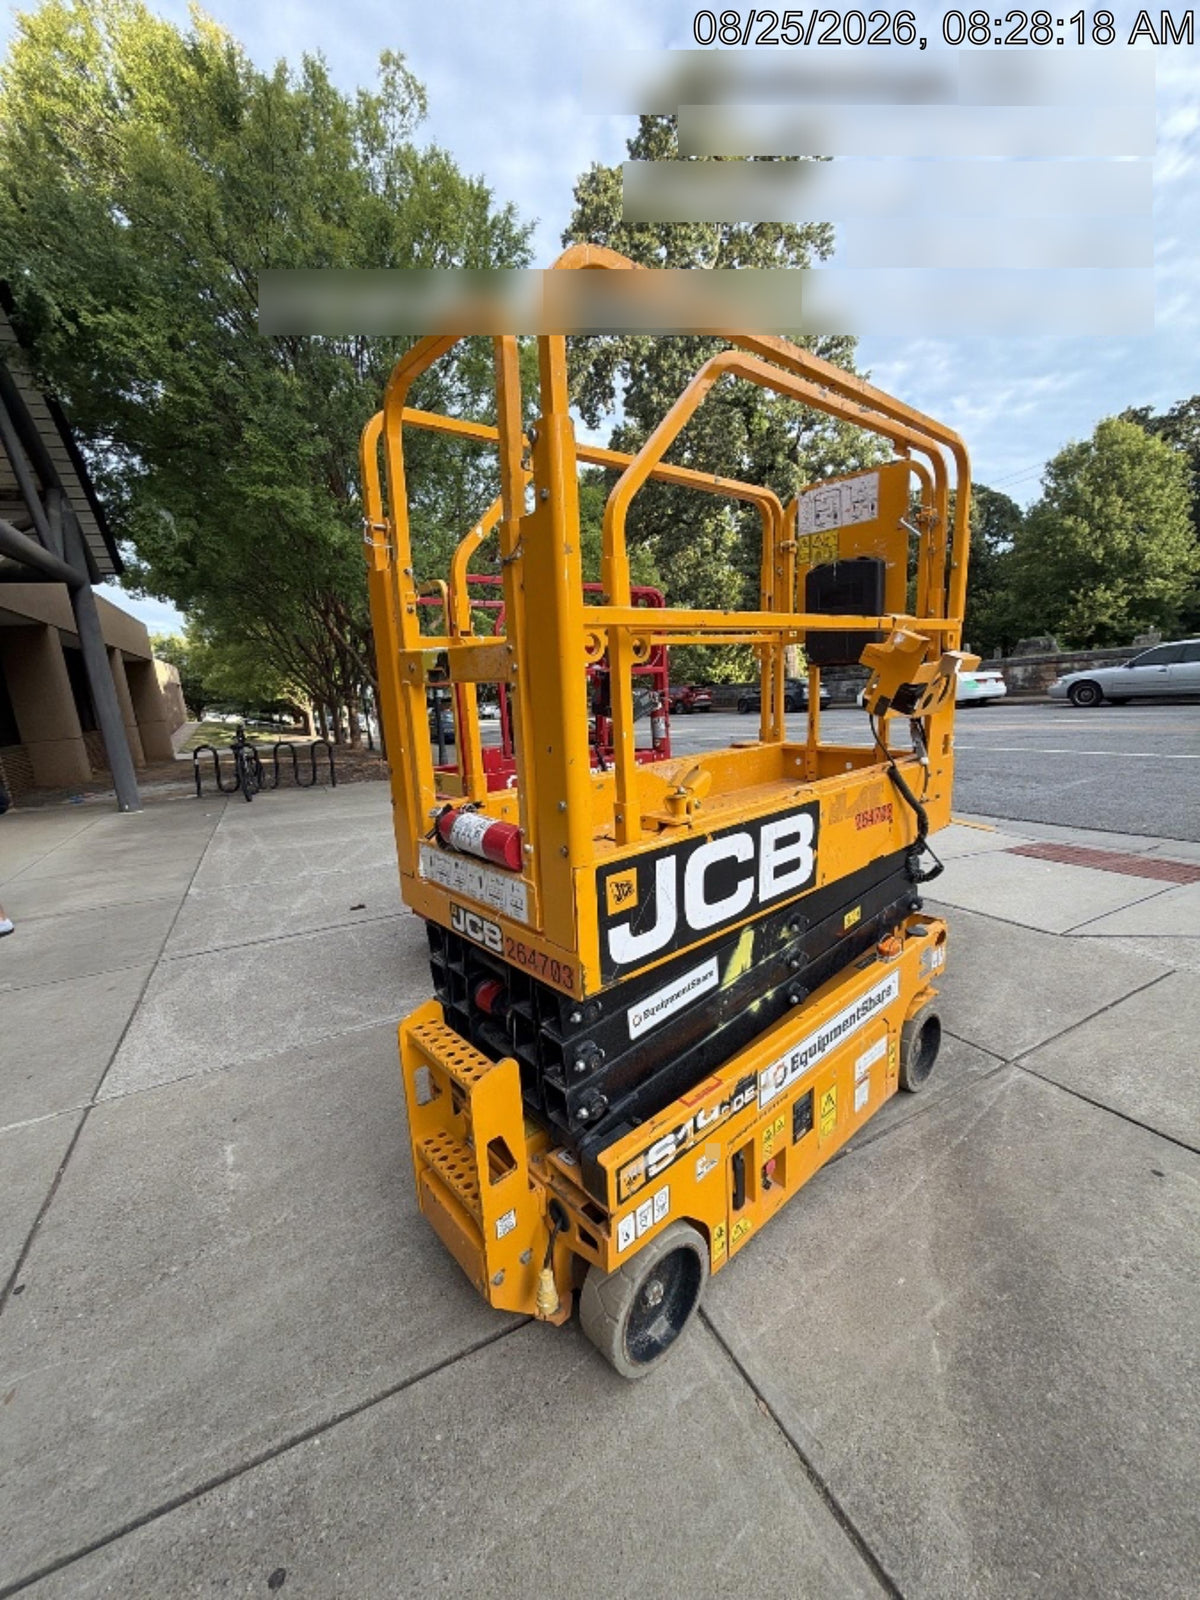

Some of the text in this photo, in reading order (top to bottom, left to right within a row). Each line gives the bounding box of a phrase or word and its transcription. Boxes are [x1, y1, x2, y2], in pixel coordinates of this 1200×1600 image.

[607, 812, 815, 965] JCB
[452, 907, 503, 953] JCB
[506, 937, 574, 990] 264703
[643, 969, 714, 1020] EquipmentShare
[790, 984, 893, 1073] EquipmentShare
